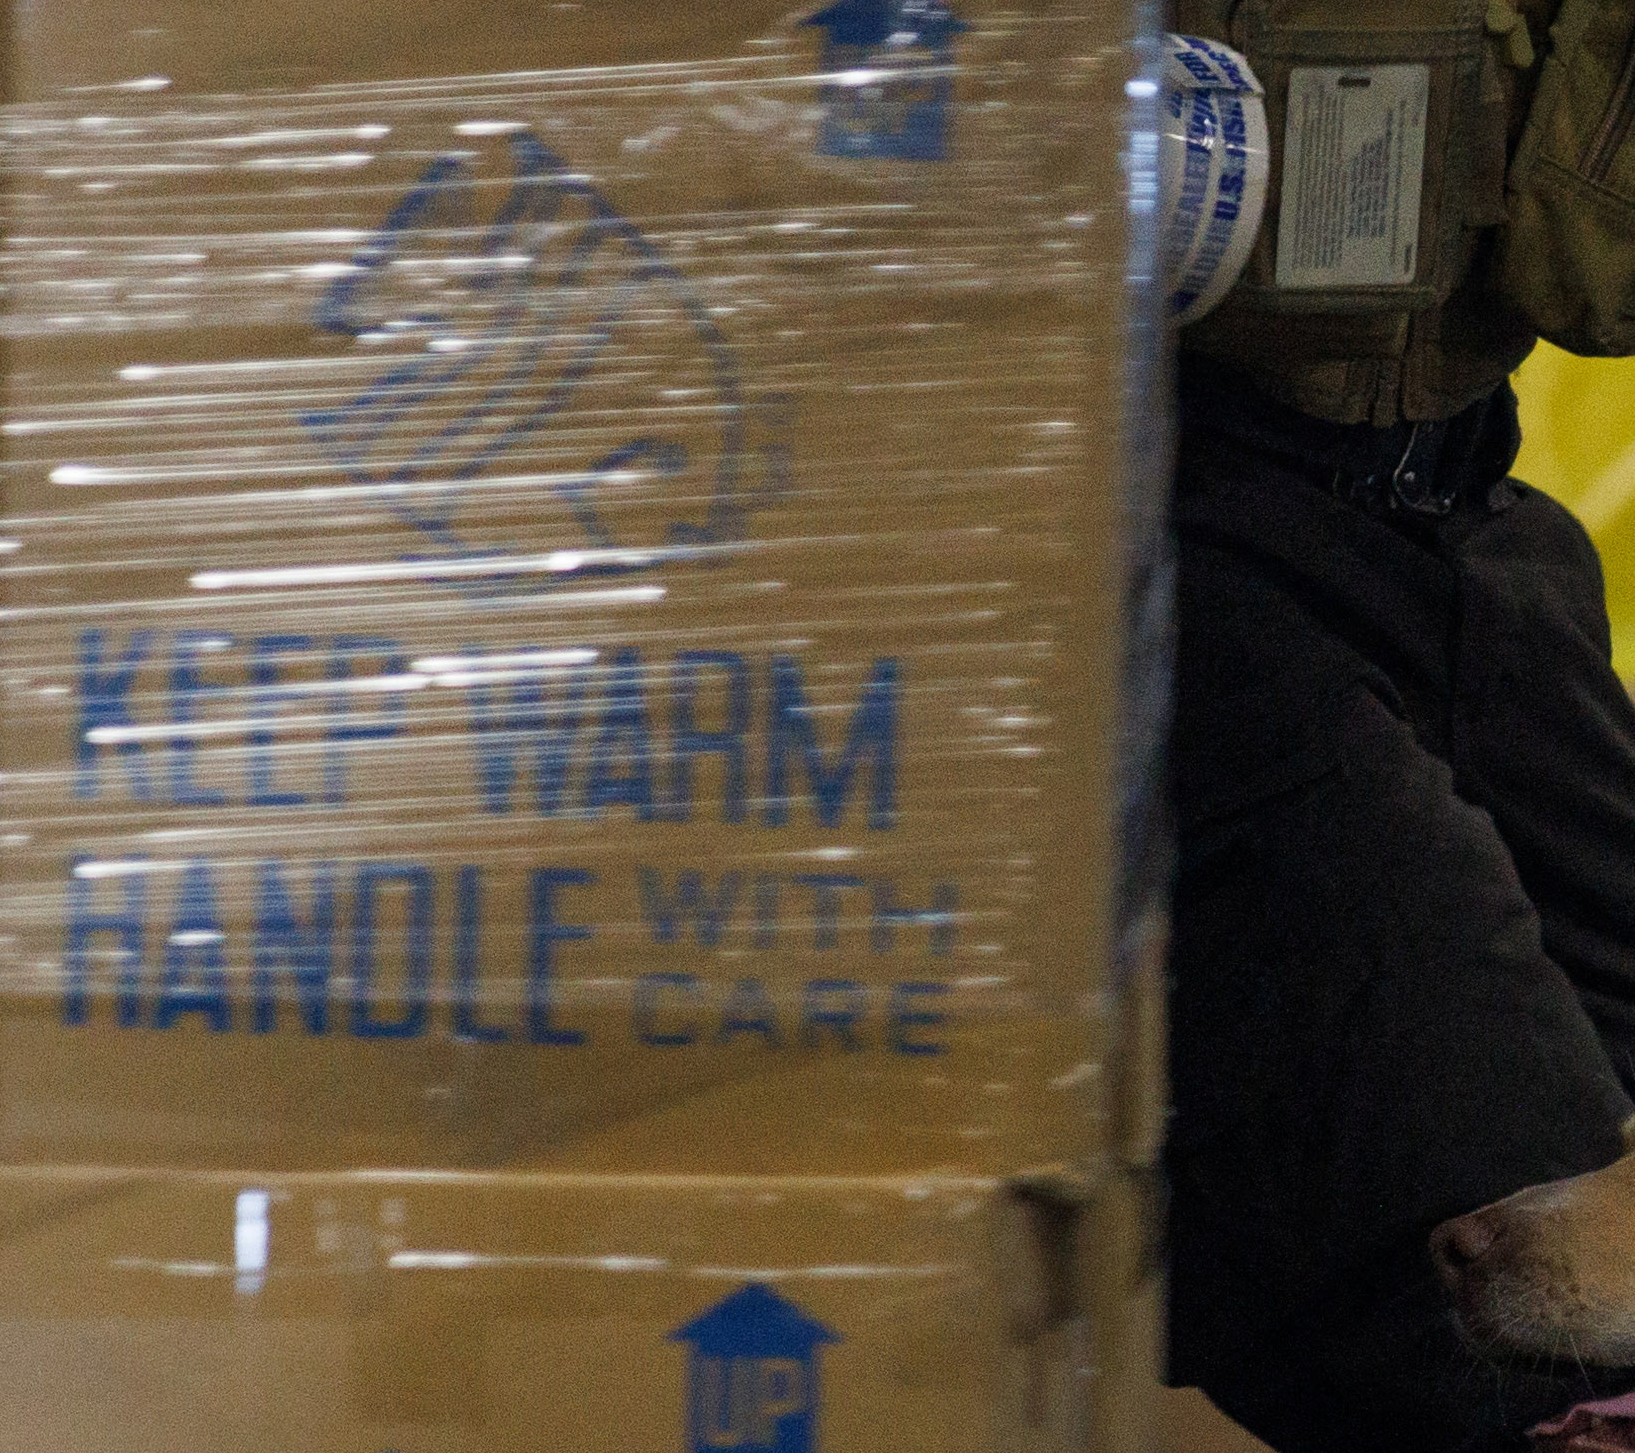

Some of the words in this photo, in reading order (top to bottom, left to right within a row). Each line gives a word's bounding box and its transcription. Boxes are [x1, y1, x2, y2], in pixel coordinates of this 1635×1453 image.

[71, 628, 406, 806] KEEP
[466, 646, 902, 832] WARM
[62, 855, 591, 1045] HANDLE
[640, 864, 962, 956] WITH
[633, 972, 952, 1056] CARE
[698, 1357, 802, 1446] UP
